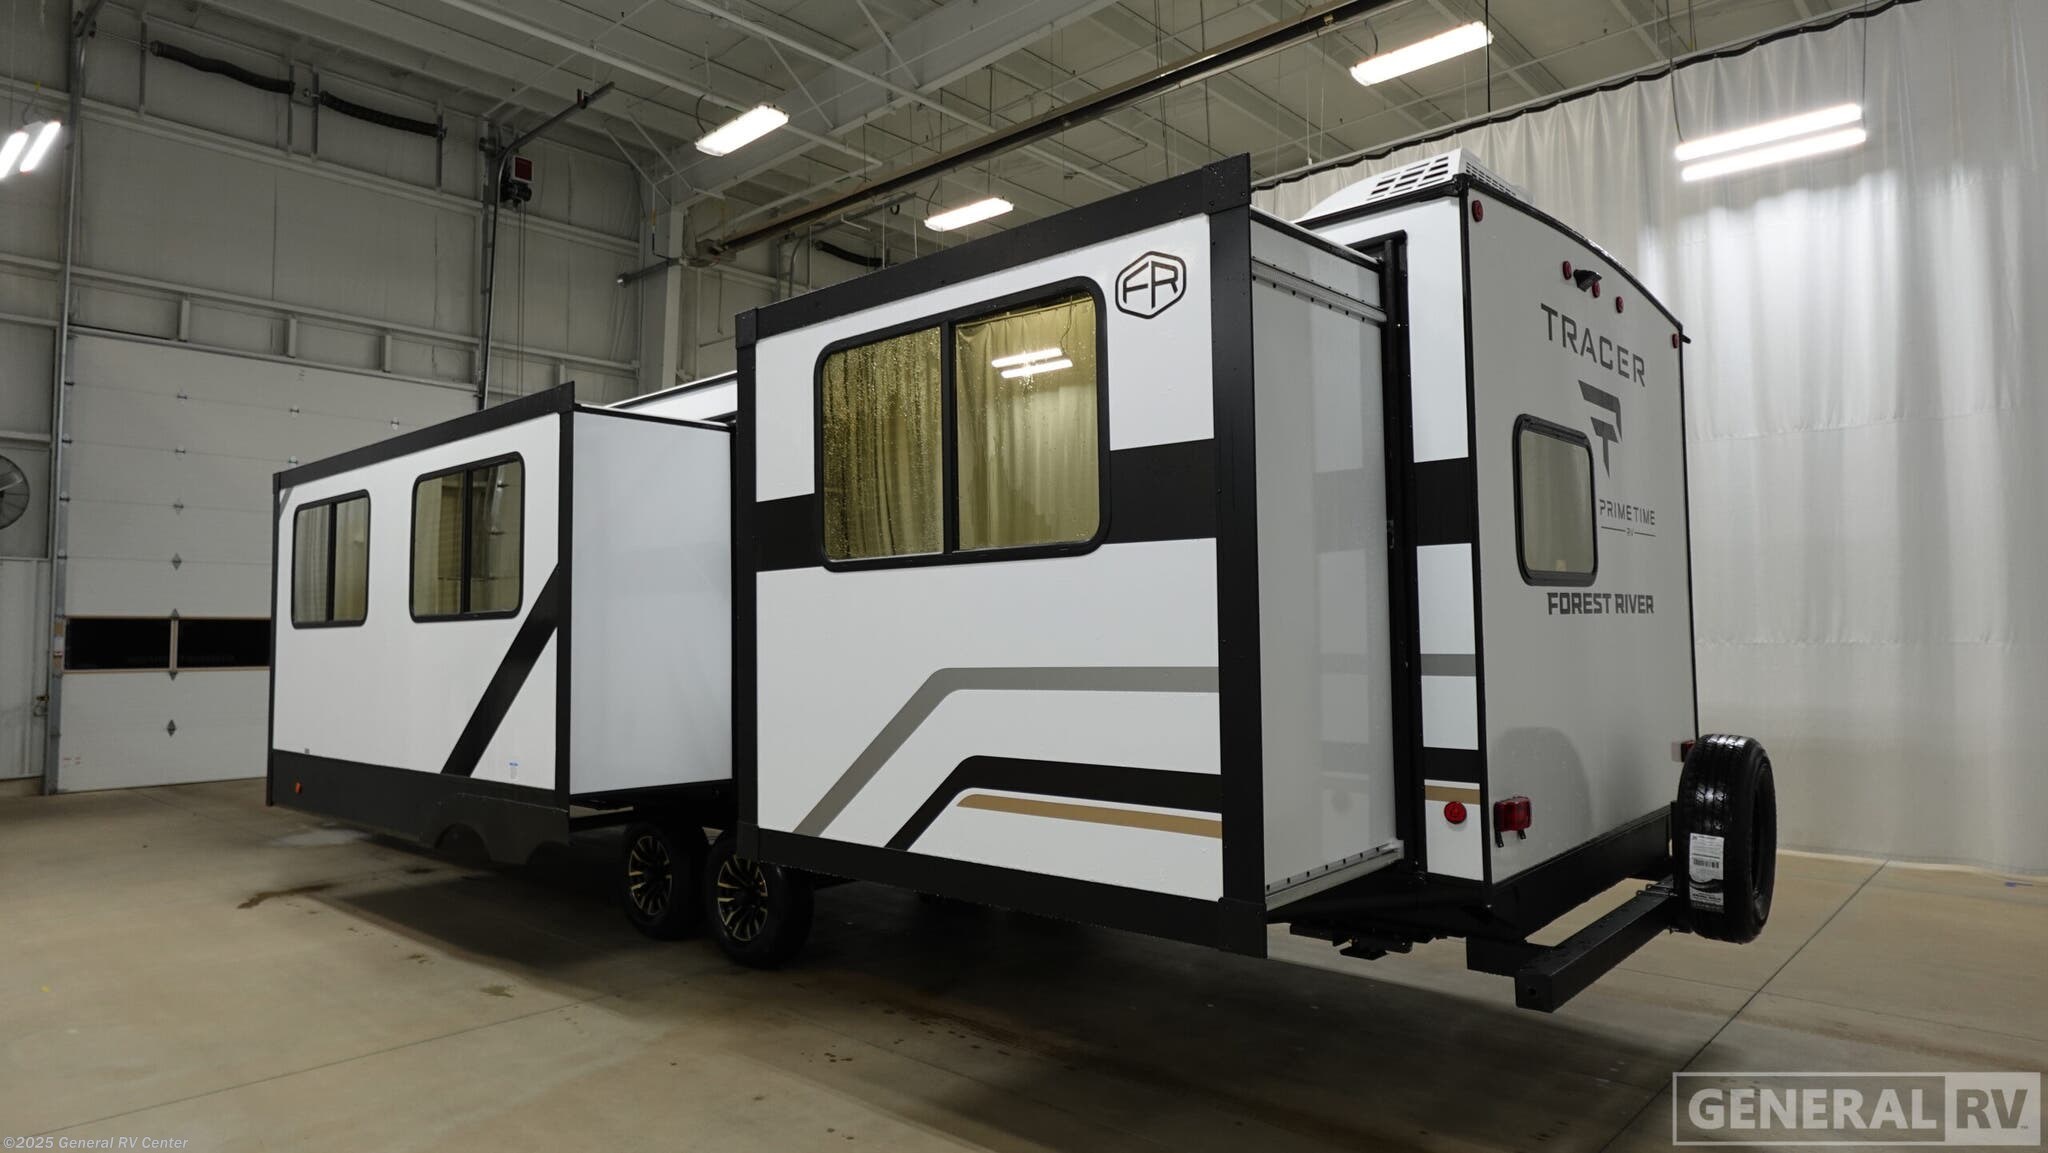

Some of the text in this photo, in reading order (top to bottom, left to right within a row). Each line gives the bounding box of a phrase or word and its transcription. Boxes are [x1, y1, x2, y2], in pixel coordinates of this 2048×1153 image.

[1541, 303, 1646, 387] TRACER
[1546, 592, 1655, 616] FOREST RIVER
